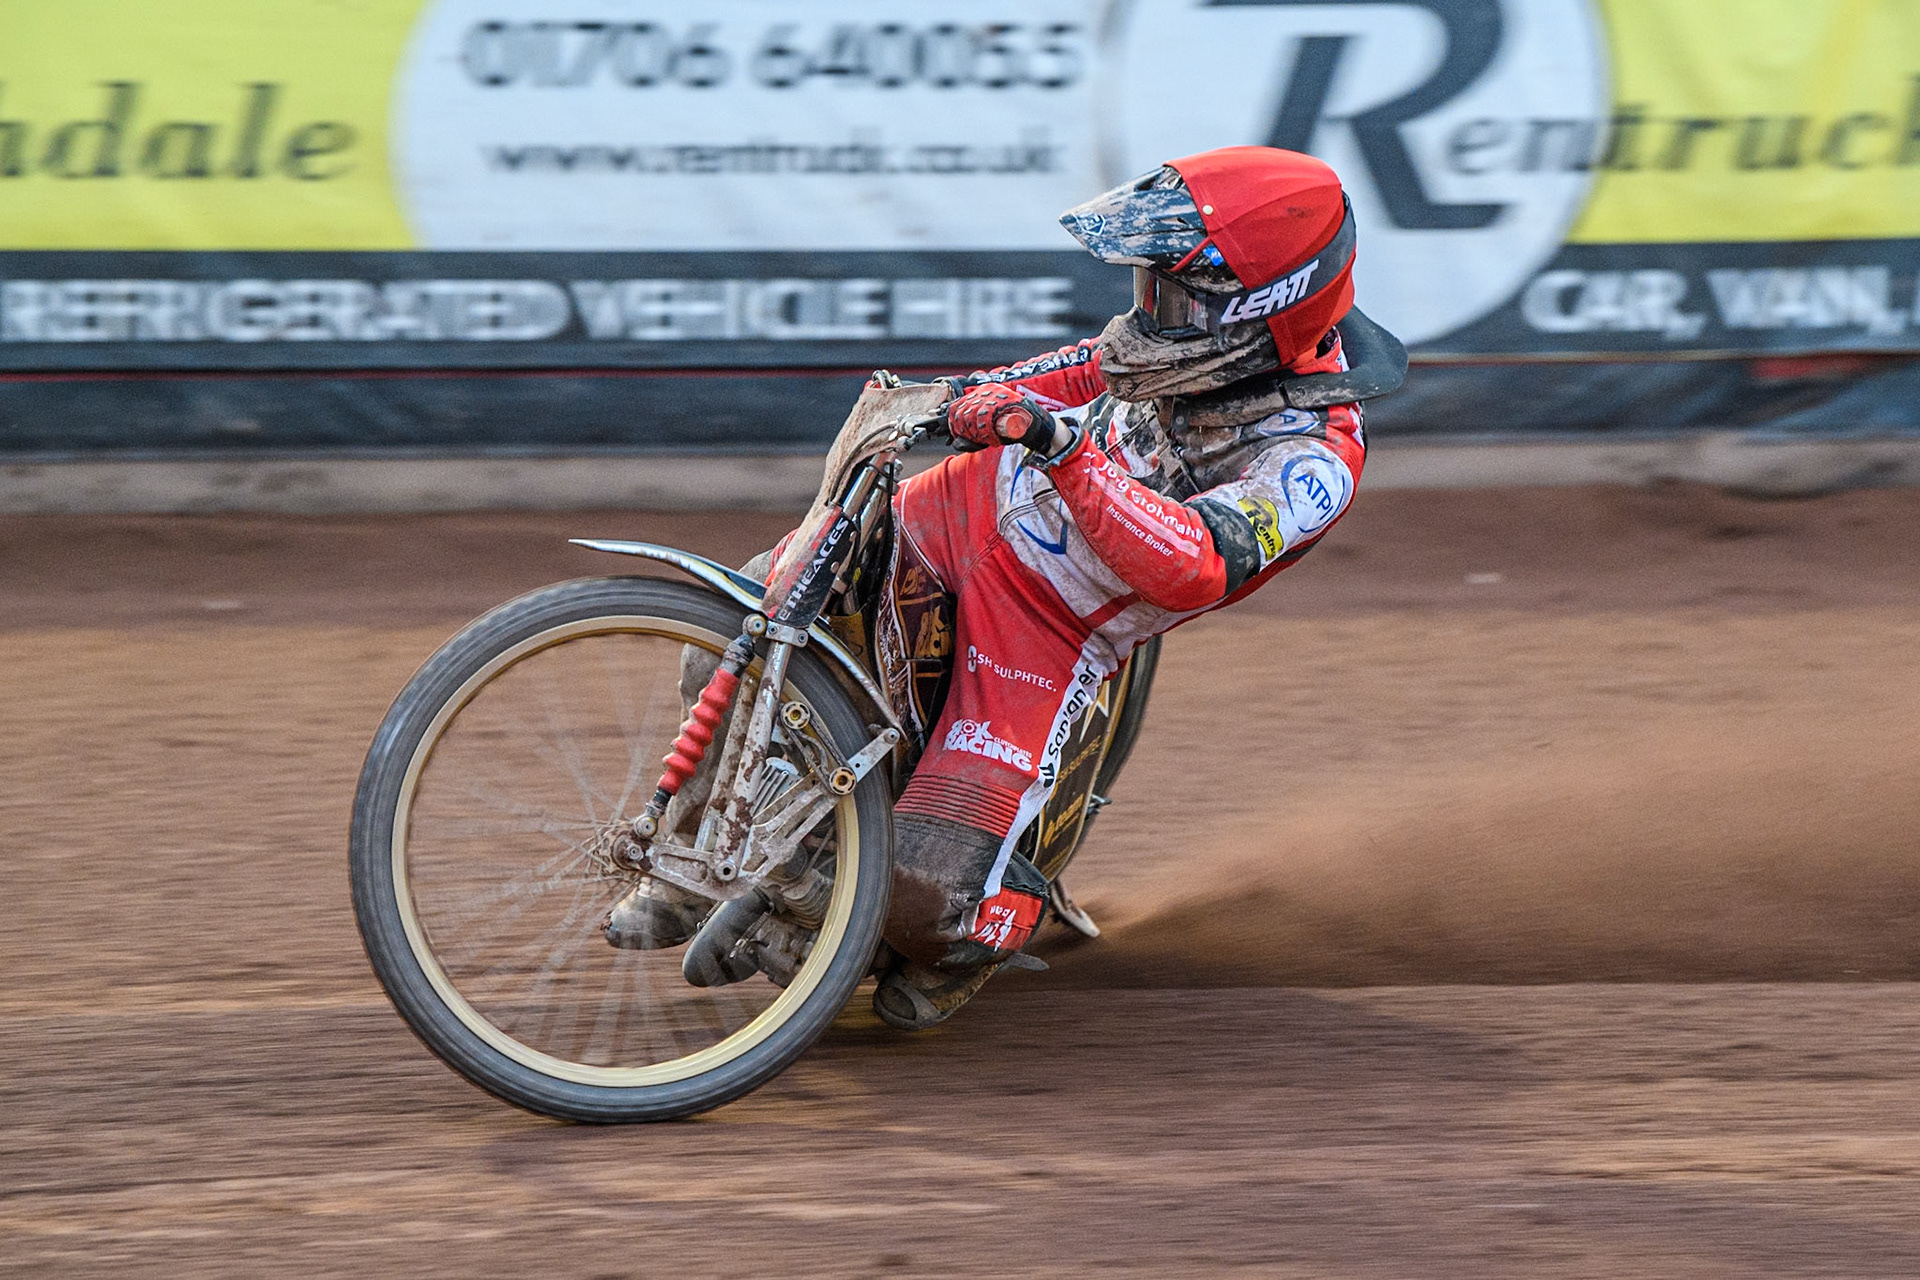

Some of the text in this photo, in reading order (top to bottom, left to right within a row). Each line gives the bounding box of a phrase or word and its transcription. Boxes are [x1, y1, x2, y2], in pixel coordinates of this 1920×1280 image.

[460, 20, 732, 88] 01706
[892, 276, 1074, 340] HIRE
[1220, 259, 1319, 324] LEATT
[1294, 473, 1334, 521] ATPI
[1105, 503, 1174, 557] Insurance Broker
